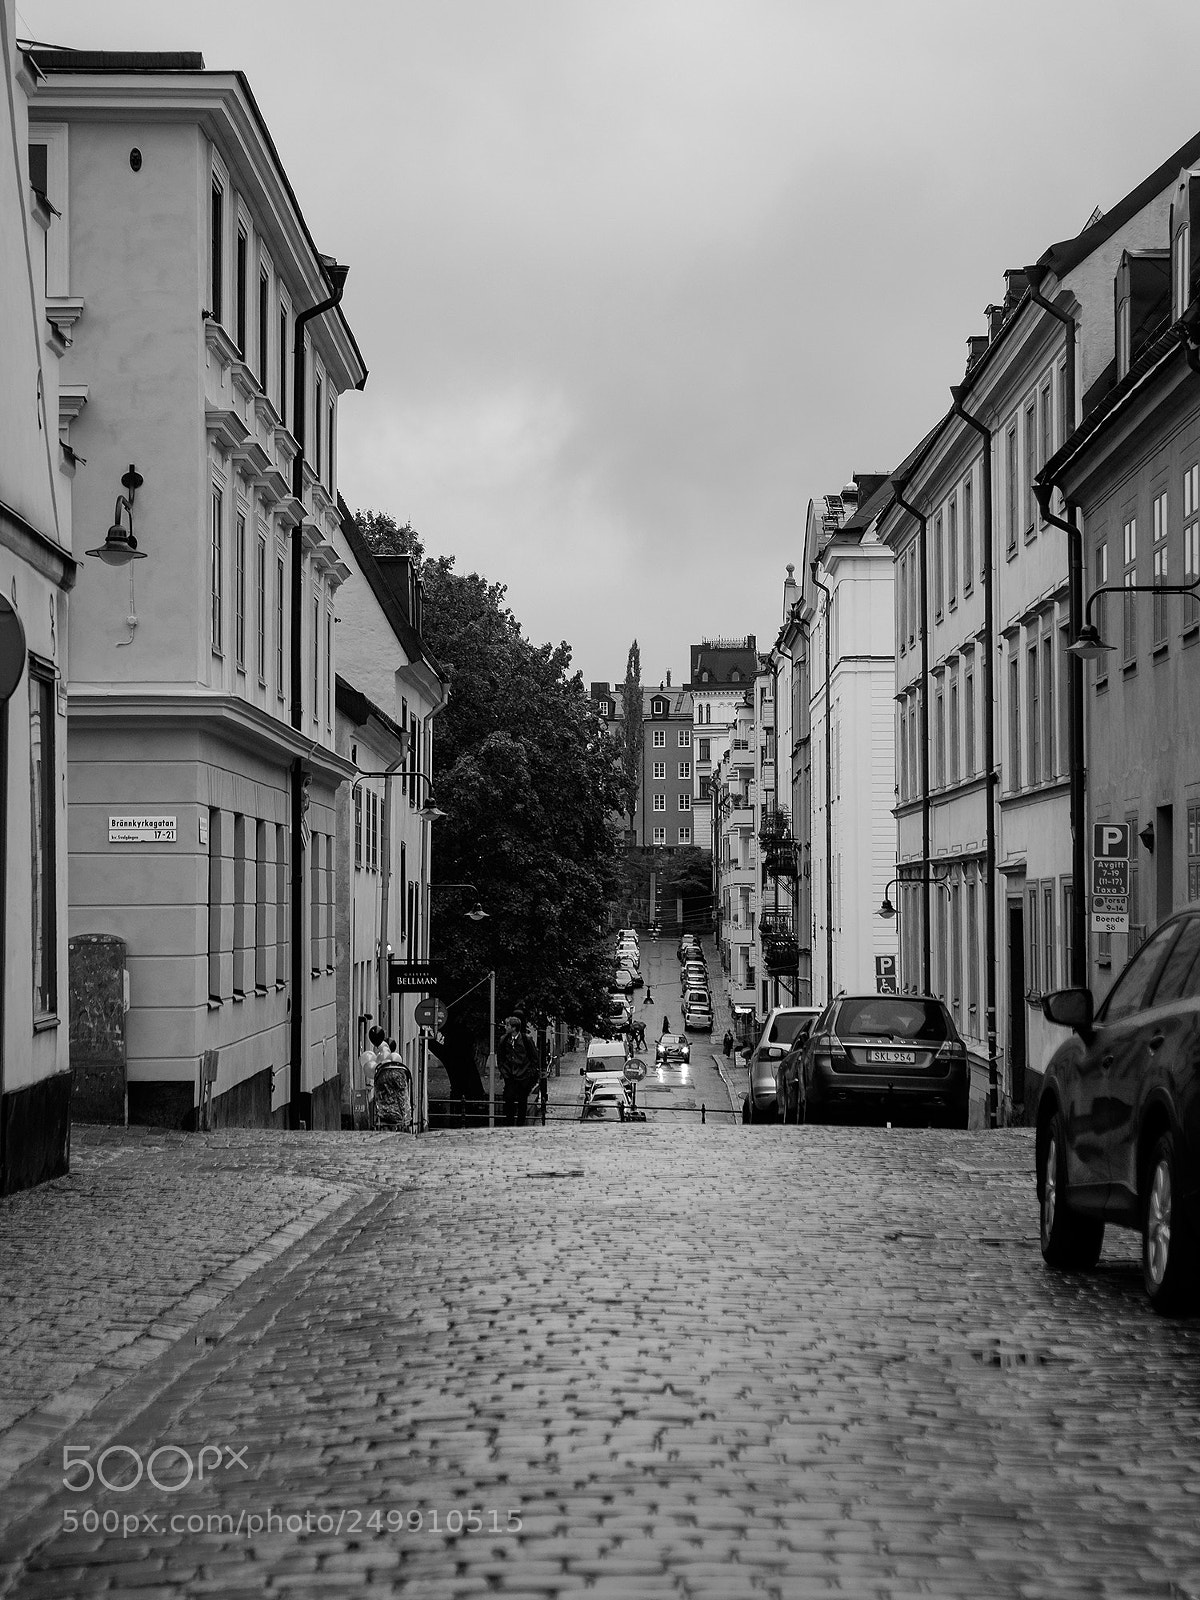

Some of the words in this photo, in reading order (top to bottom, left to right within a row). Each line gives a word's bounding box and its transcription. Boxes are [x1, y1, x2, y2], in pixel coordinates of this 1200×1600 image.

[111, 819, 174, 828] Brännkyrkagatan
[154, 831, 174, 840] 17-21
[1102, 826, 1123, 855] P
[1098, 861, 1125, 870] Avgift
[1098, 878, 1123, 886] (11-17)
[1096, 886, 1117, 894] Taxa
[1120, 886, 1126, 894] 3
[1095, 915, 1125, 923] Boende
[1105, 923, 1116, 931] Sö
[880, 957, 893, 975] P
[396, 976, 438, 985] BELLMAN
[874, 1052, 892, 1061] SKL
[893, 1053, 912, 1062] 954
